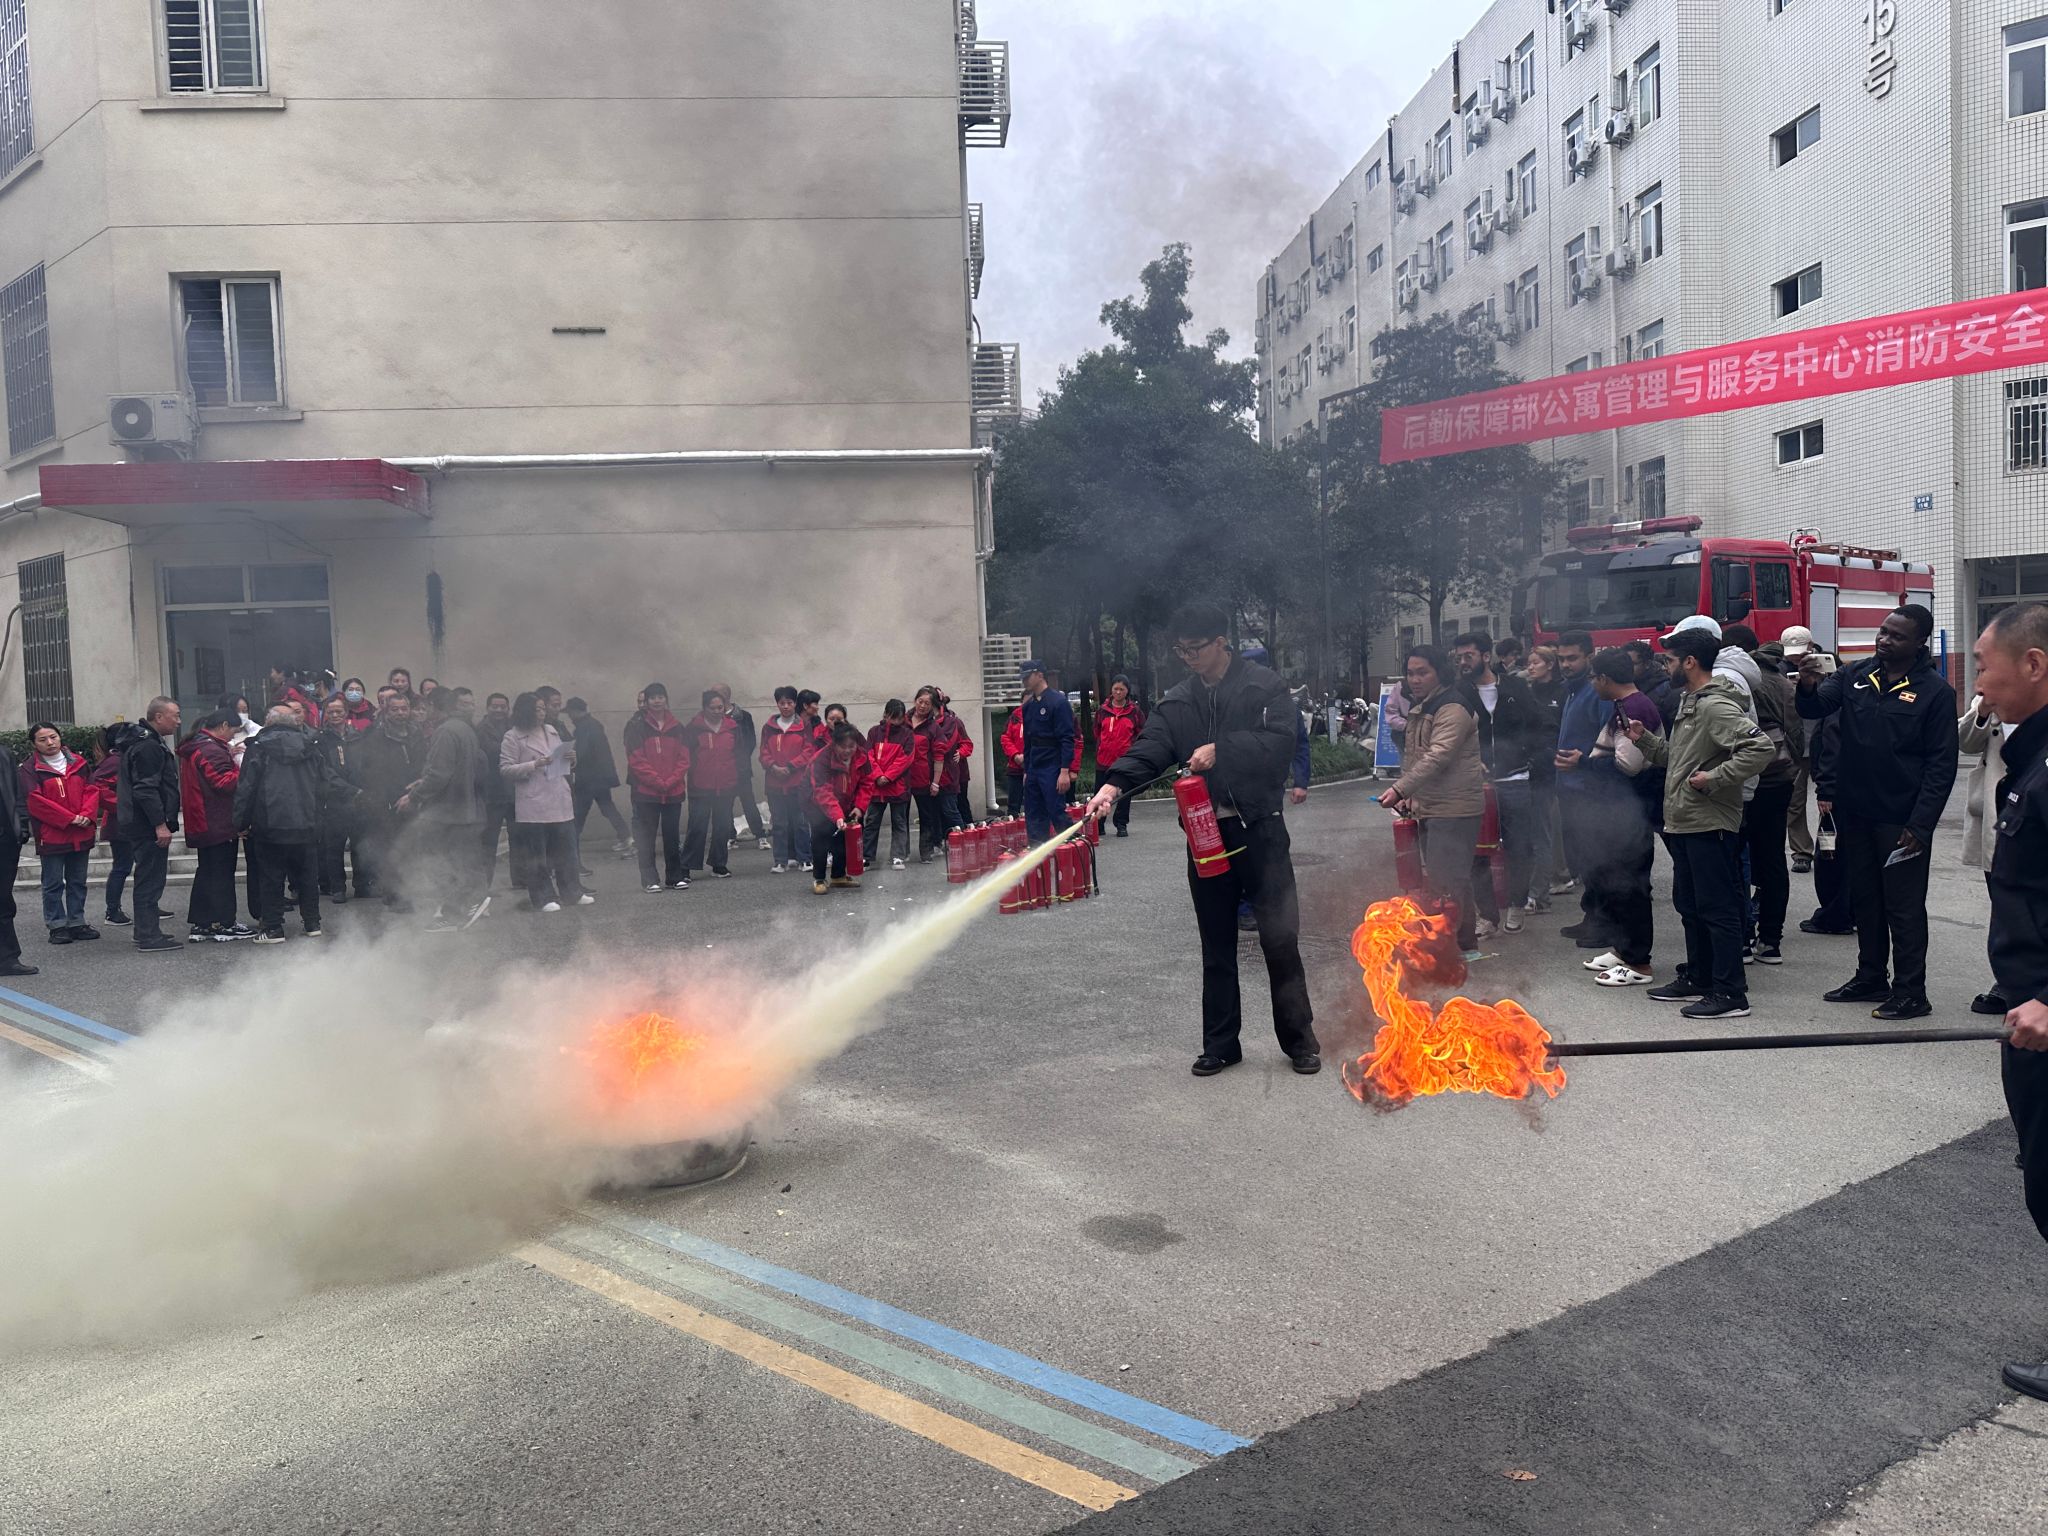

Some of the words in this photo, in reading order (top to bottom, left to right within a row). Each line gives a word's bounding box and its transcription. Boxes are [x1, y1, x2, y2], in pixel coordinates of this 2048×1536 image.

[1402, 303, 2046, 450] 后勤保障部公寓管理与服务中心消防安全
